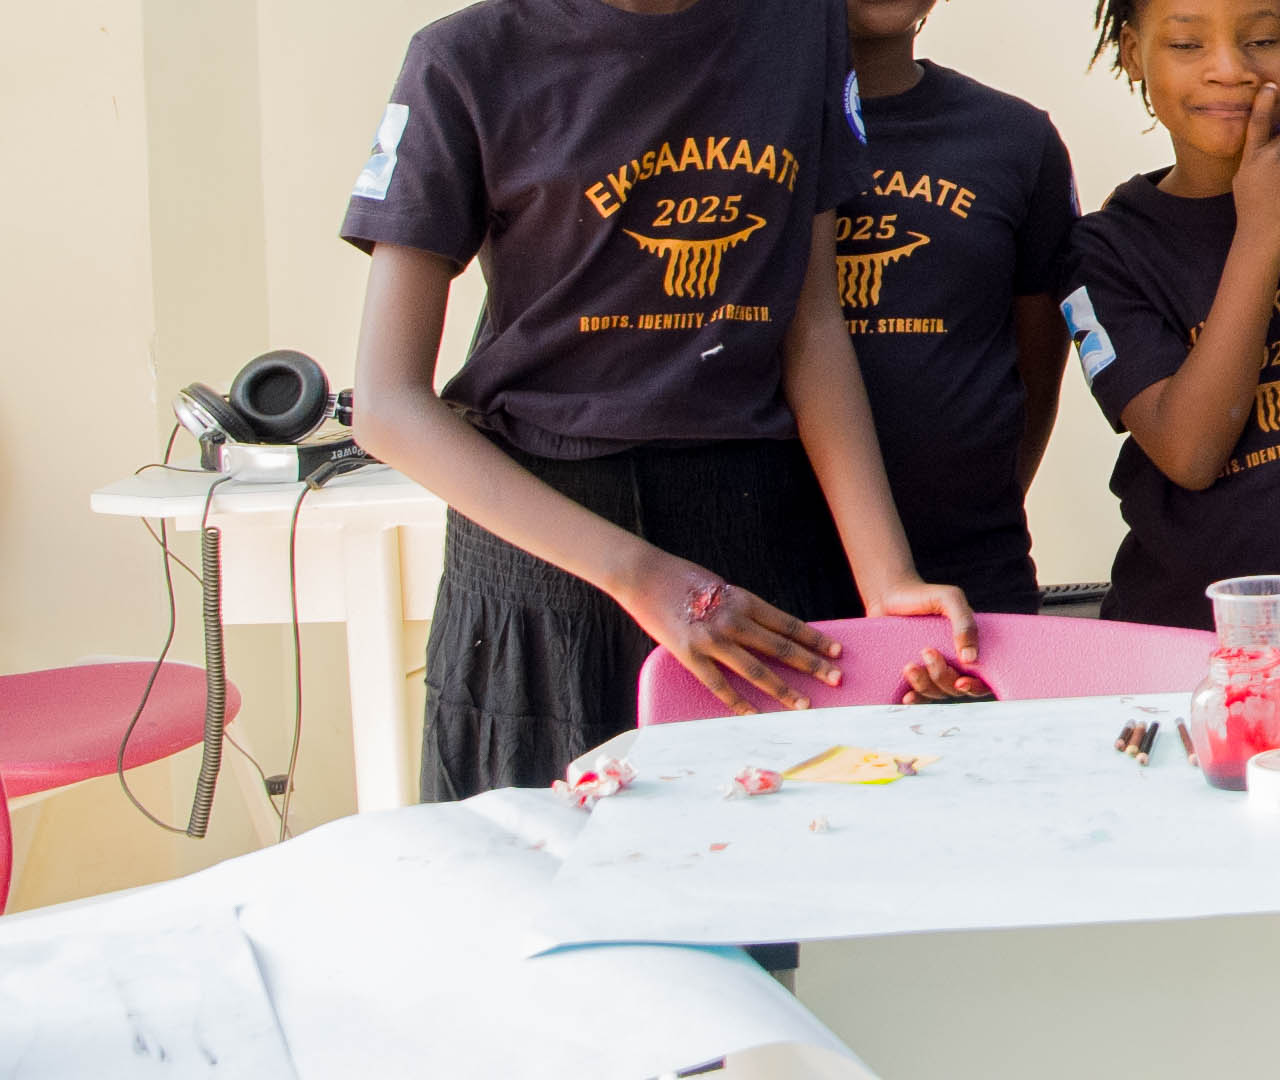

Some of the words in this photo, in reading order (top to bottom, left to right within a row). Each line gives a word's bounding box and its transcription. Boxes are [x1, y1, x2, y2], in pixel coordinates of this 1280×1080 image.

[652, 194, 743, 228] 2025
[836, 213, 898, 242] 025
[579, 314, 634, 333] ROOTS.
[638, 311, 709, 330] IDENTITY.
